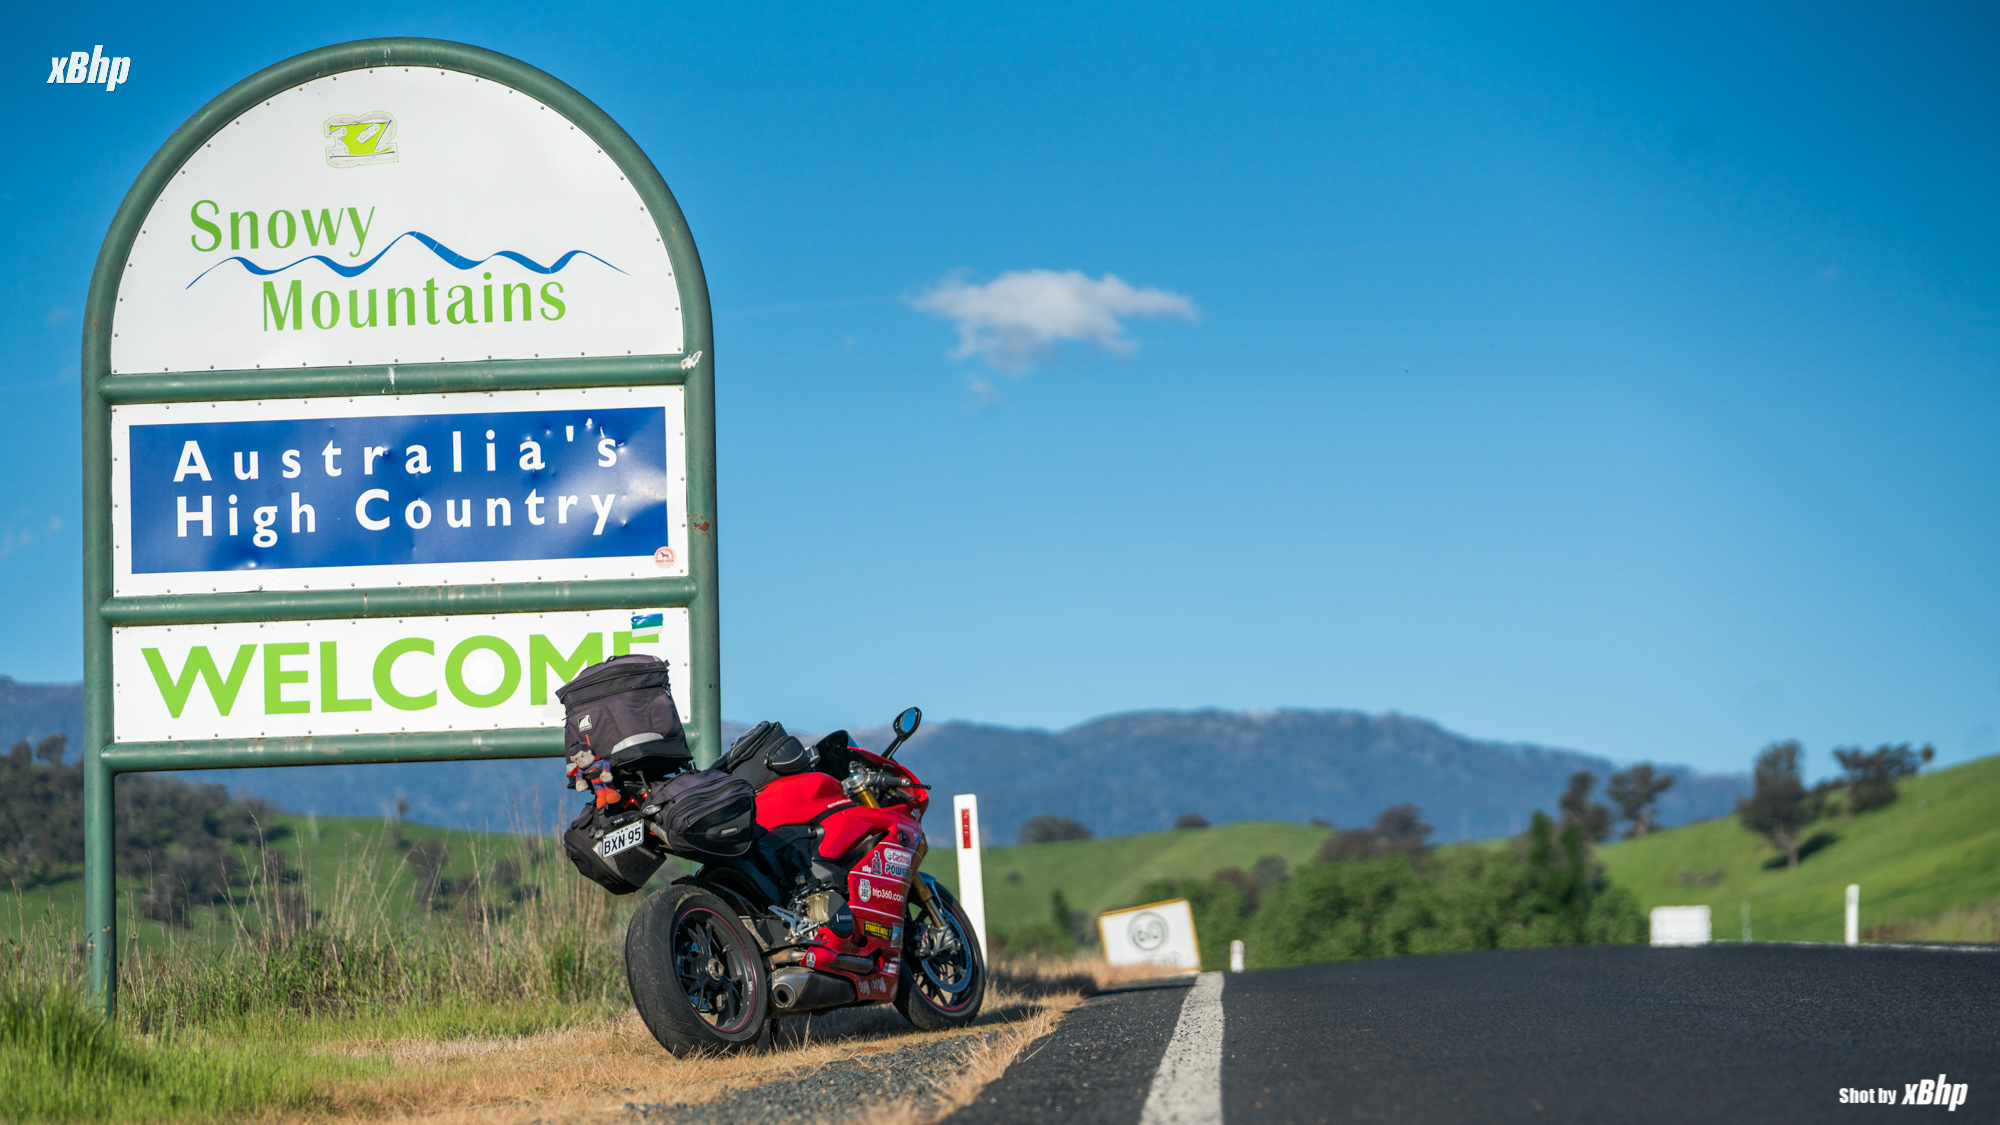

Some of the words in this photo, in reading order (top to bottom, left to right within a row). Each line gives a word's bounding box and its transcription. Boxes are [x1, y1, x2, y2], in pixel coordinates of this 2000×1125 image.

[190, 199, 376, 258] Snowy
[263, 271, 566, 332] Mountains
[173, 425, 618, 483] Australia's
[176, 491, 316, 548] High
[355, 488, 616, 536] Country
[604, 833, 626, 855] BXN
[627, 826, 641, 845] 95
